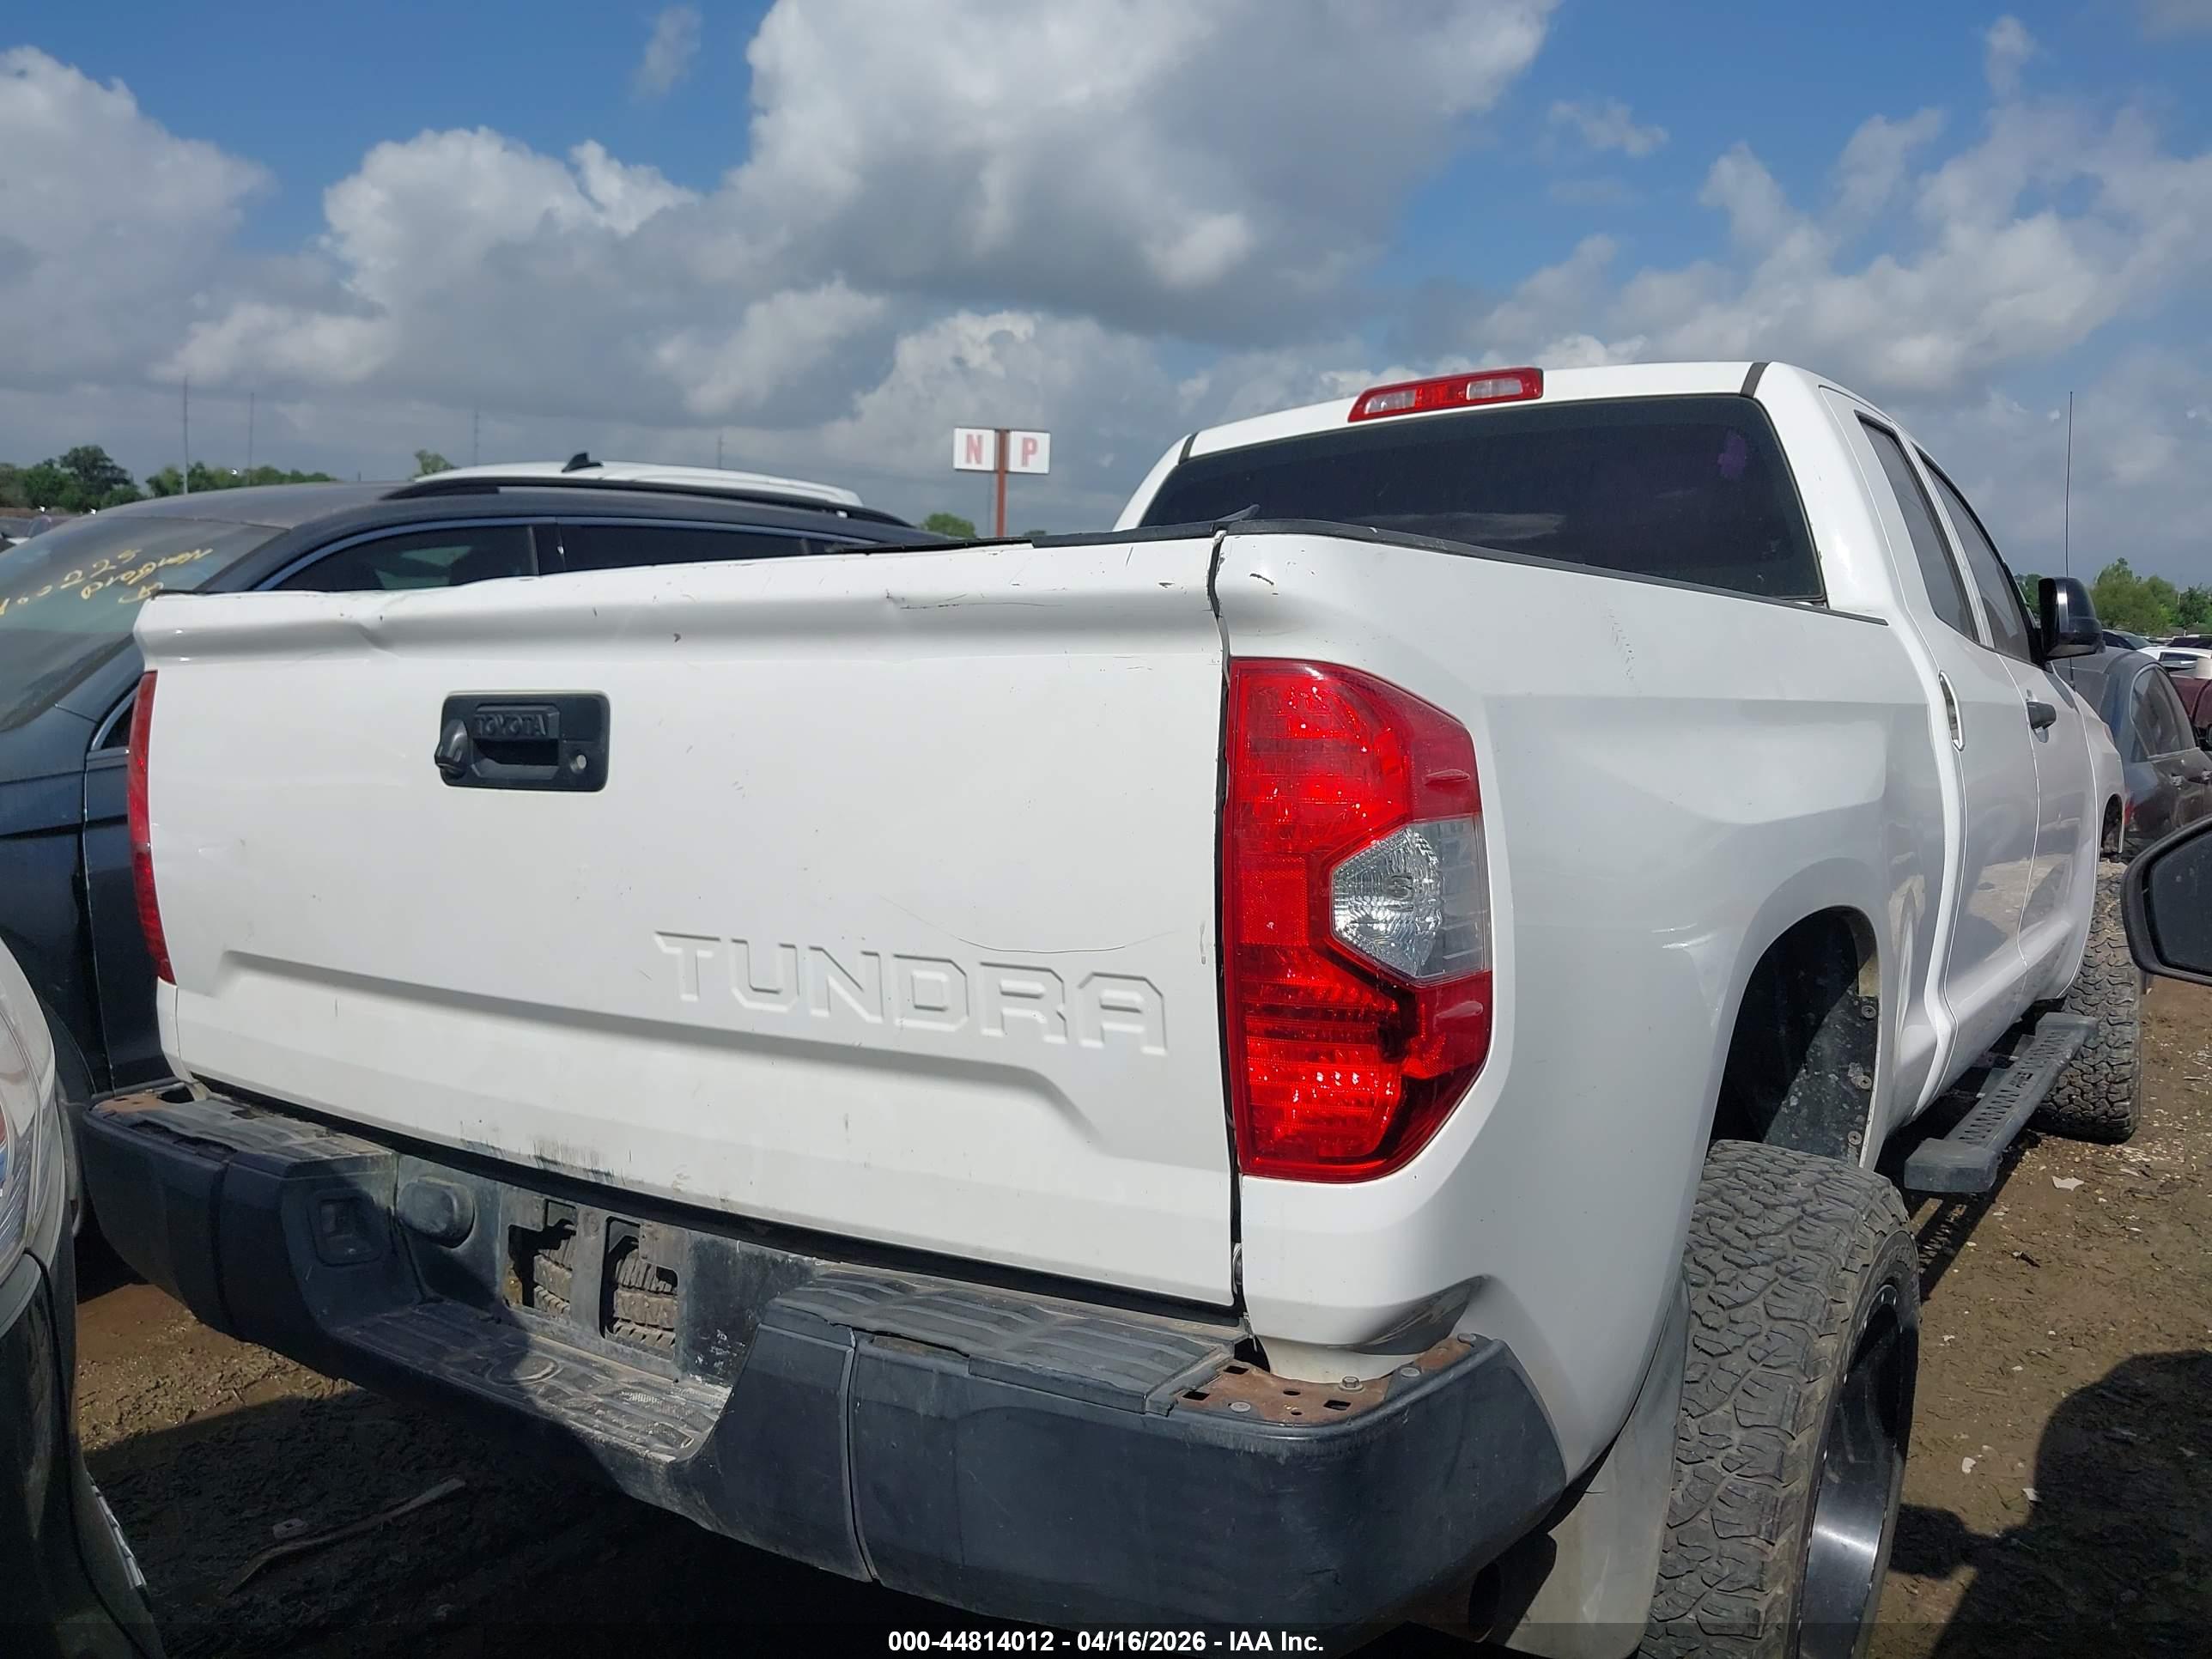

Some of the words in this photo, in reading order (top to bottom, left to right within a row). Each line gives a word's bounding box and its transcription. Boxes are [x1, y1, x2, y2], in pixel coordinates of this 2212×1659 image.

[965, 434, 984, 465] N
[1021, 437, 1039, 467] P
[474, 714, 546, 736] TOYOTA
[653, 930, 1168, 1056] TUNDRA
